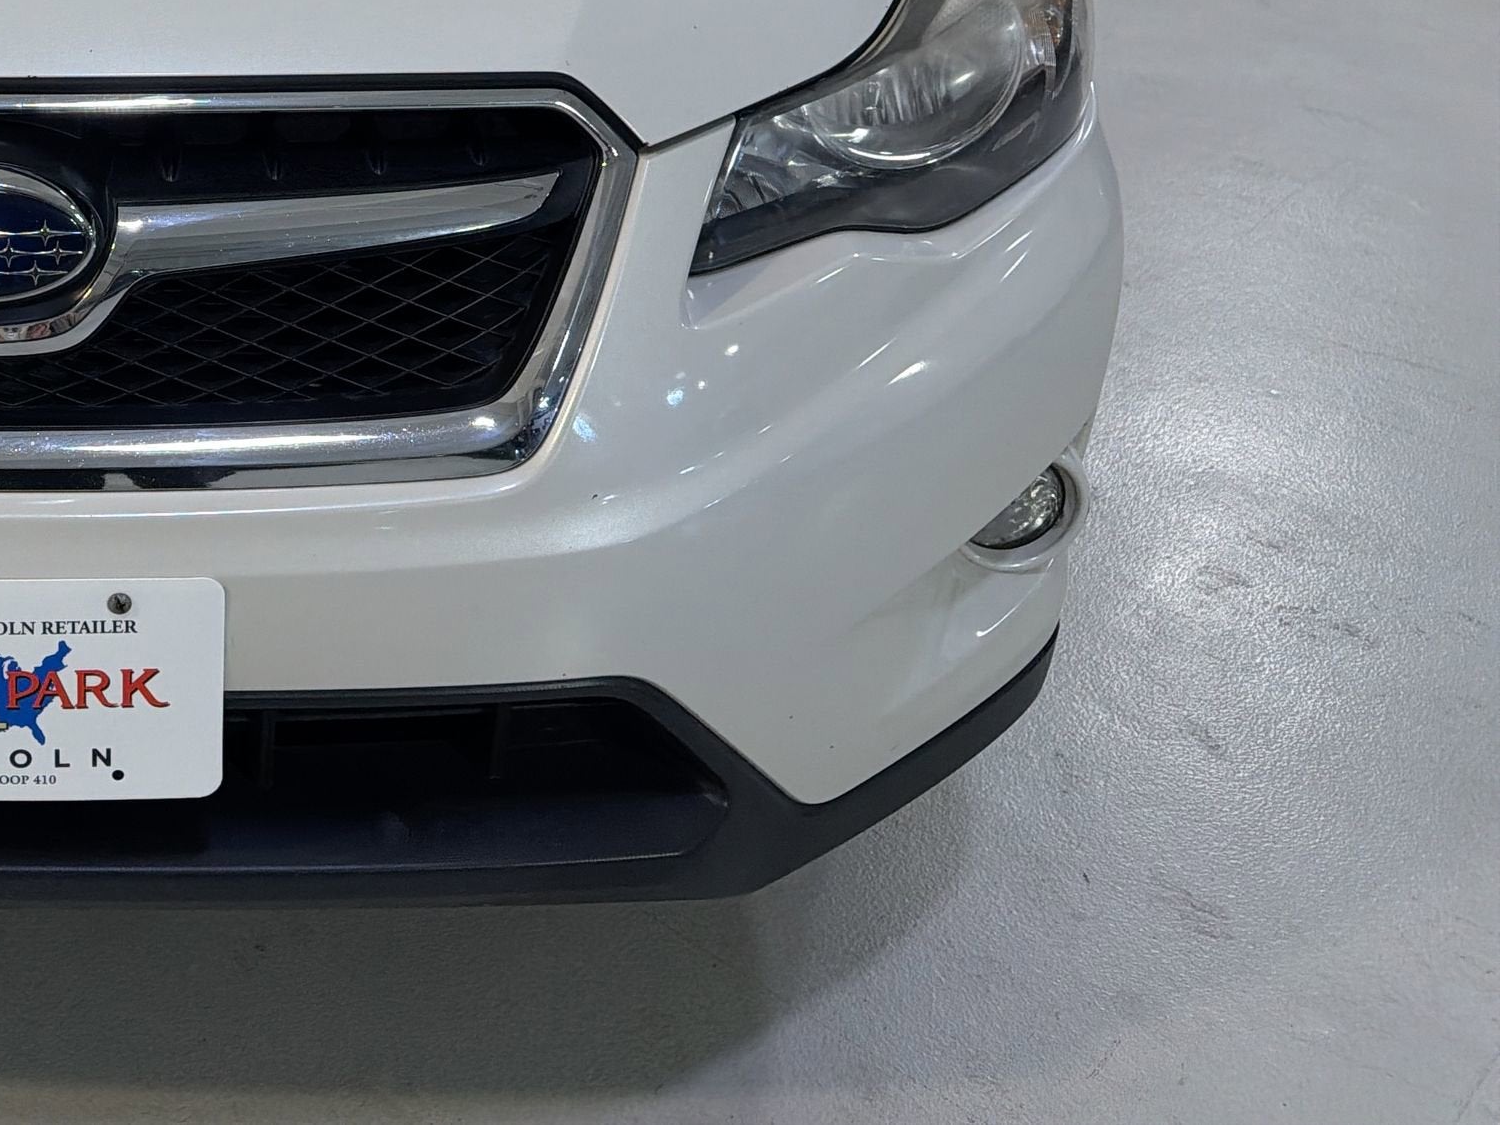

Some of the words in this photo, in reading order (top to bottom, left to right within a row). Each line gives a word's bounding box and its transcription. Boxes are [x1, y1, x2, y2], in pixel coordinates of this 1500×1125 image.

[41, 619, 138, 635] RETAILER
[6, 668, 171, 710] PARK
[33, 774, 57, 786] 410
